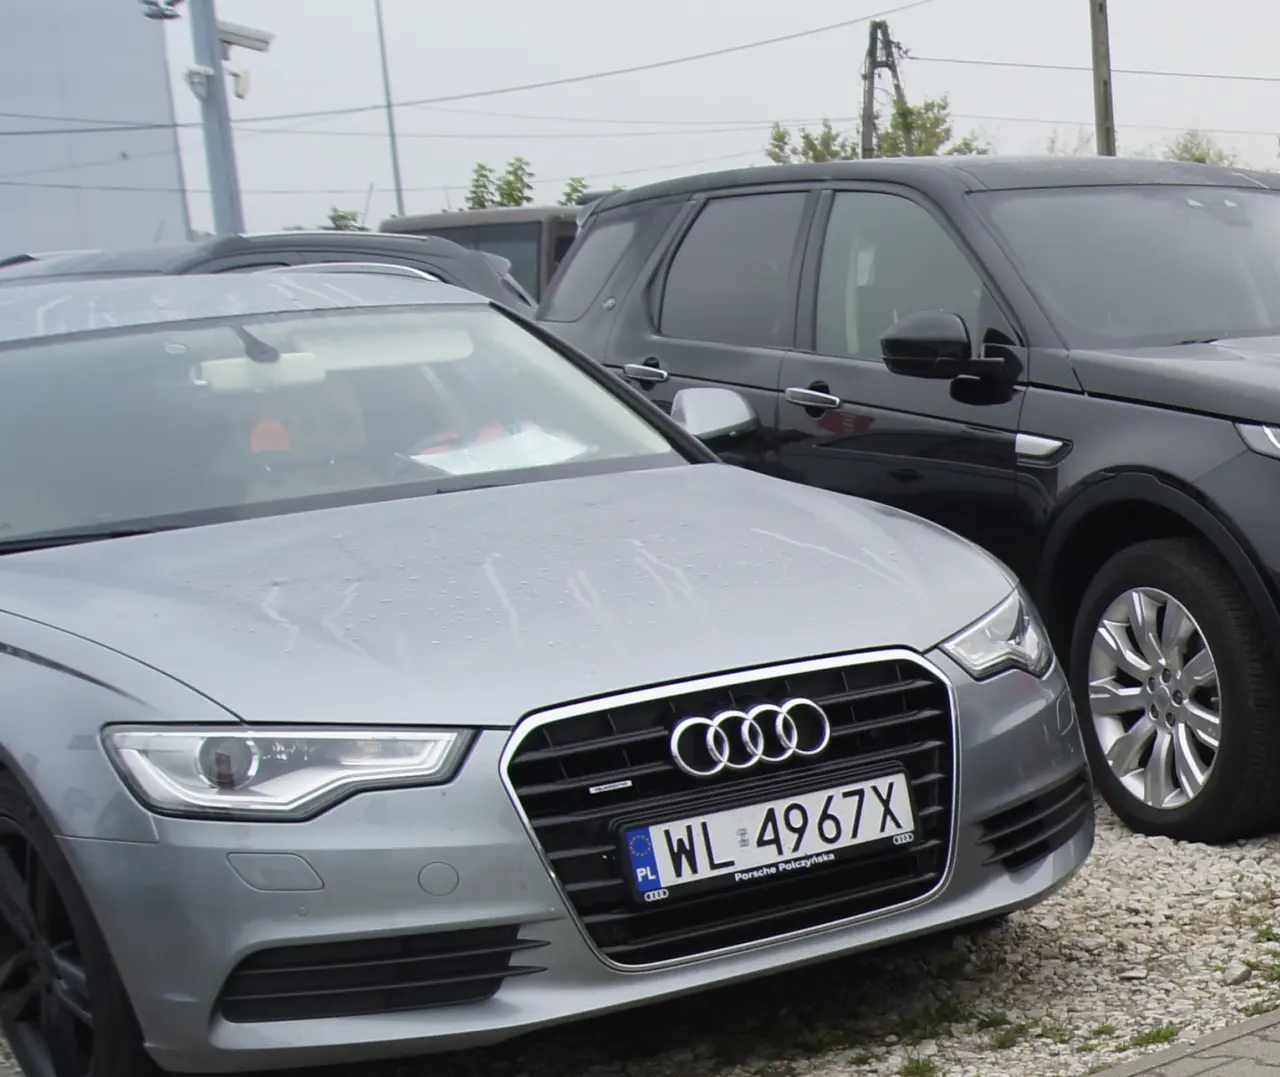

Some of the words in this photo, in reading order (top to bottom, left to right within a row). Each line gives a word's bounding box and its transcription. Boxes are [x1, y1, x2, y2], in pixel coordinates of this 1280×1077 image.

[663, 821, 736, 879] WL
[756, 780, 904, 856] 4967X
[636, 866, 657, 882] PL
[734, 866, 777, 882] Porsche
